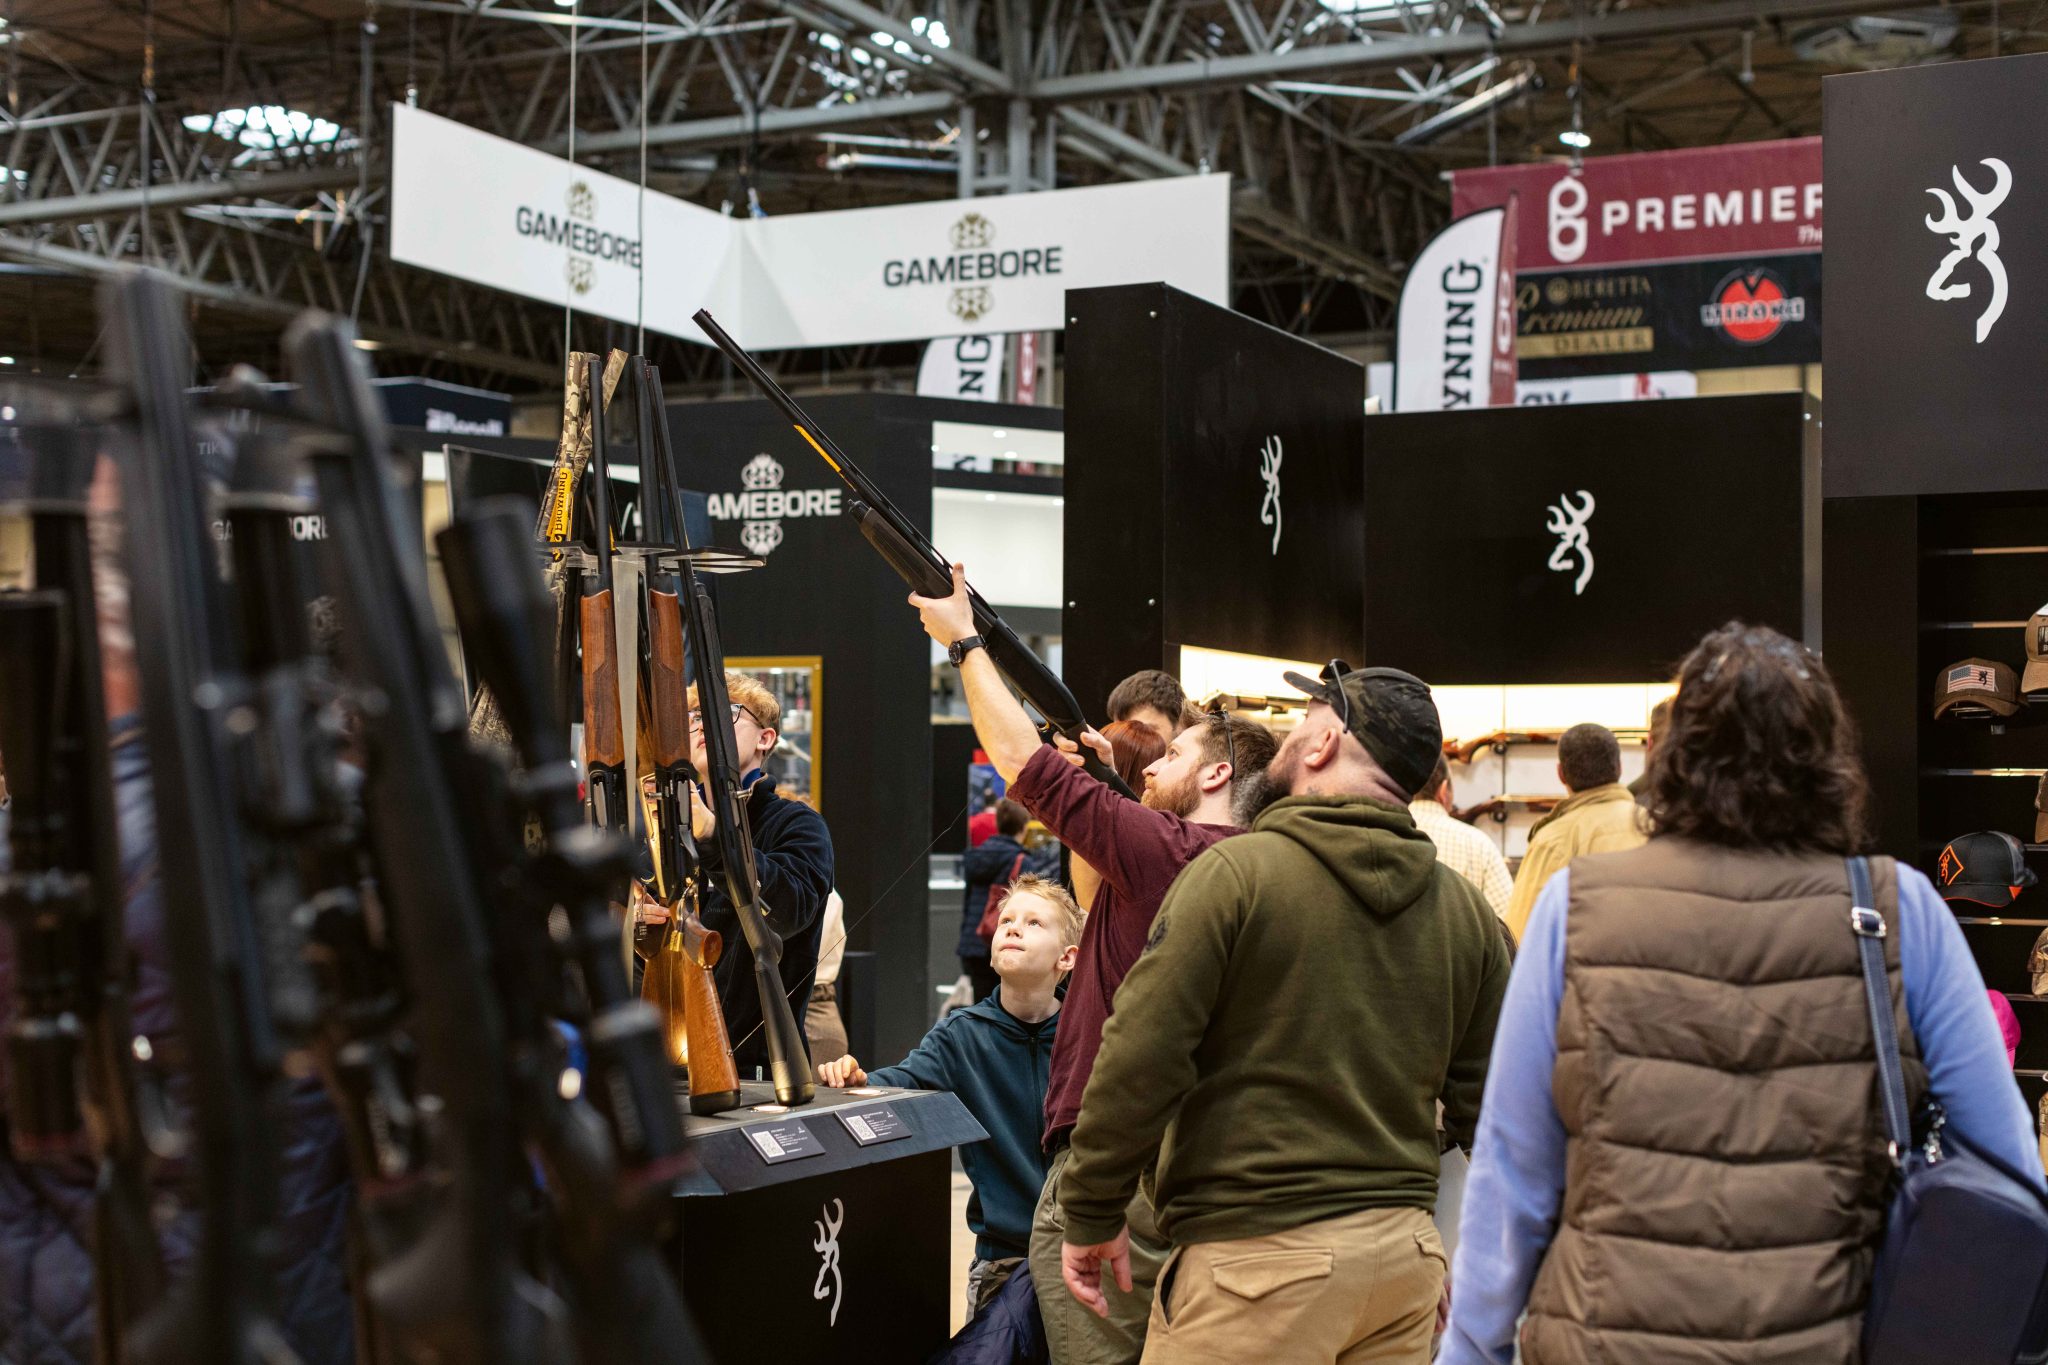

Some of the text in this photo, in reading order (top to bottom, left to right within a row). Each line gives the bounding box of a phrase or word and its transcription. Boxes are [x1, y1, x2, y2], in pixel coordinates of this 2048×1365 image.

[516, 206, 642, 269] GAMEBORE
[883, 246, 1063, 287] GAMEBORE
[554, 472, 569, 532] BROWNING
[707, 488, 842, 521] AMEBORE
